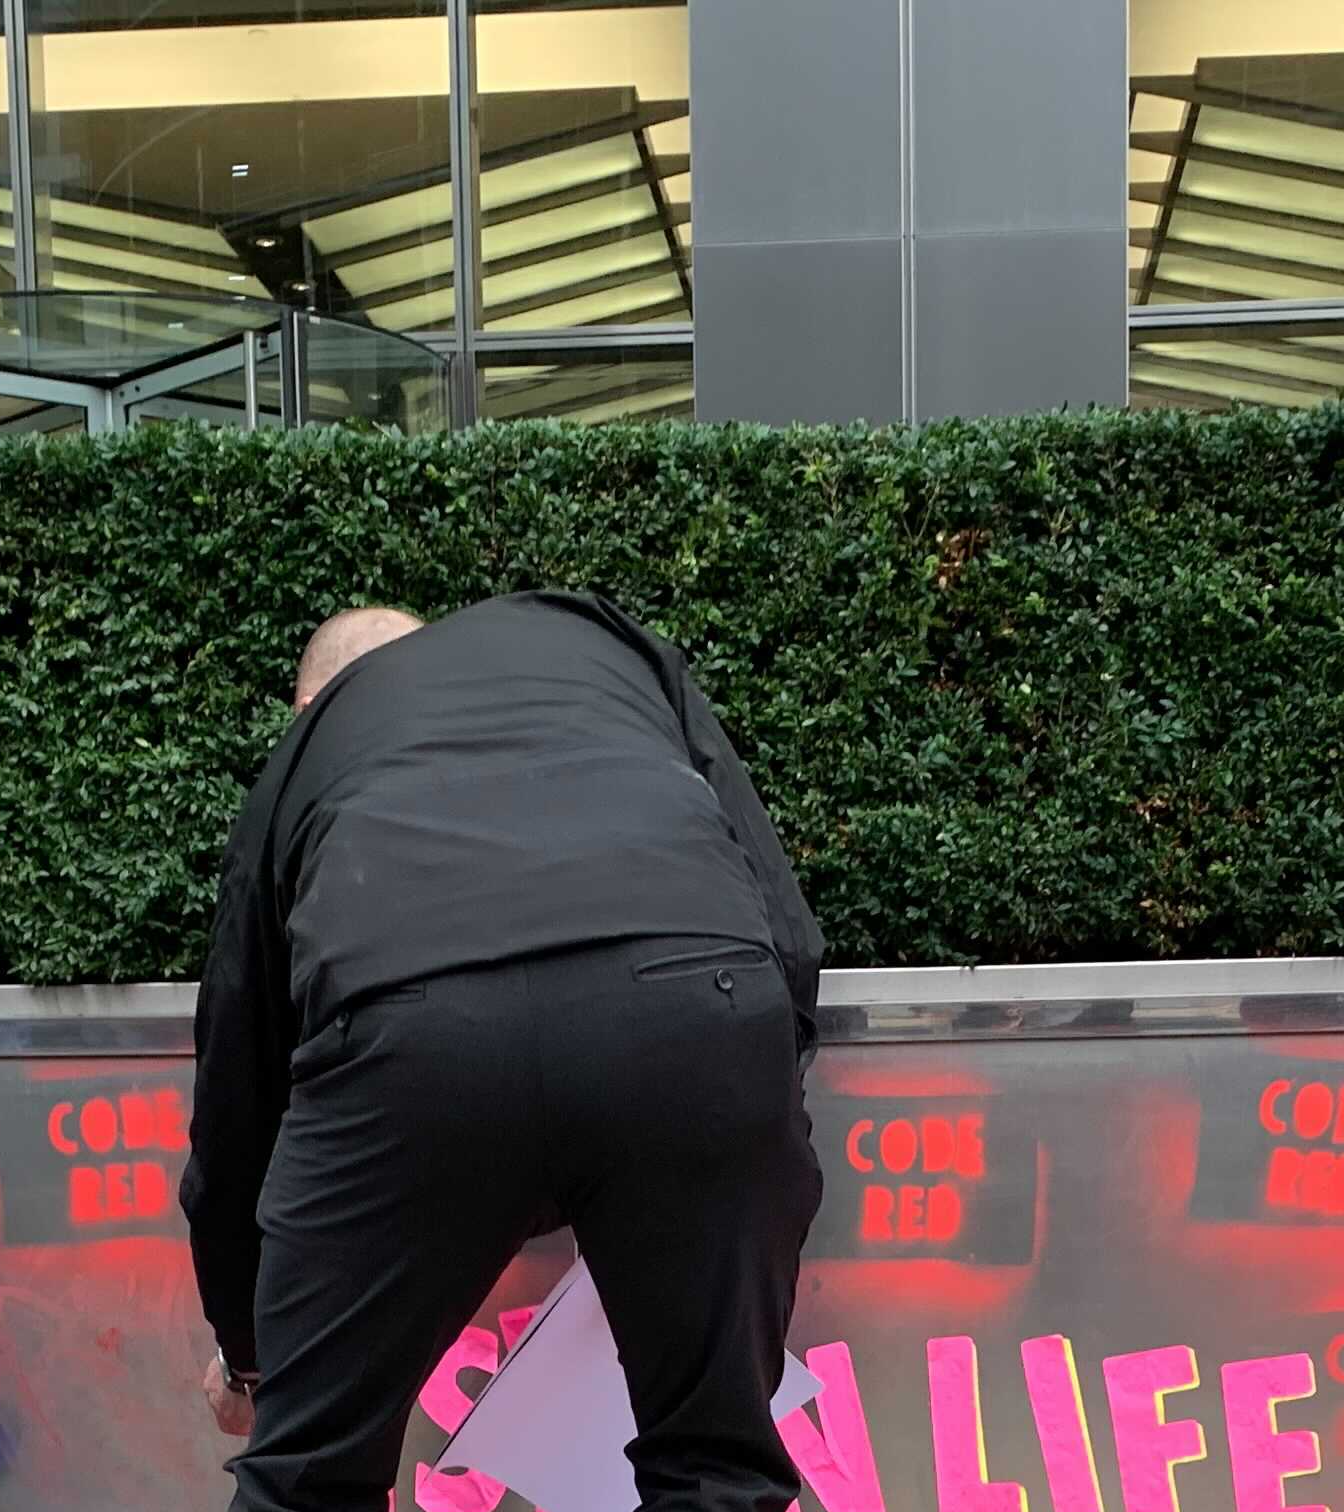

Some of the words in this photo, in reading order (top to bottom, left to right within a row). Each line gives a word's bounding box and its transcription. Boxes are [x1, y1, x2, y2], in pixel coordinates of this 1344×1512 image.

[47, 1087, 189, 1155] CODE
[846, 1113, 985, 1177] CODE
[69, 1161, 169, 1226] RED
[863, 1184, 962, 1243] RED
